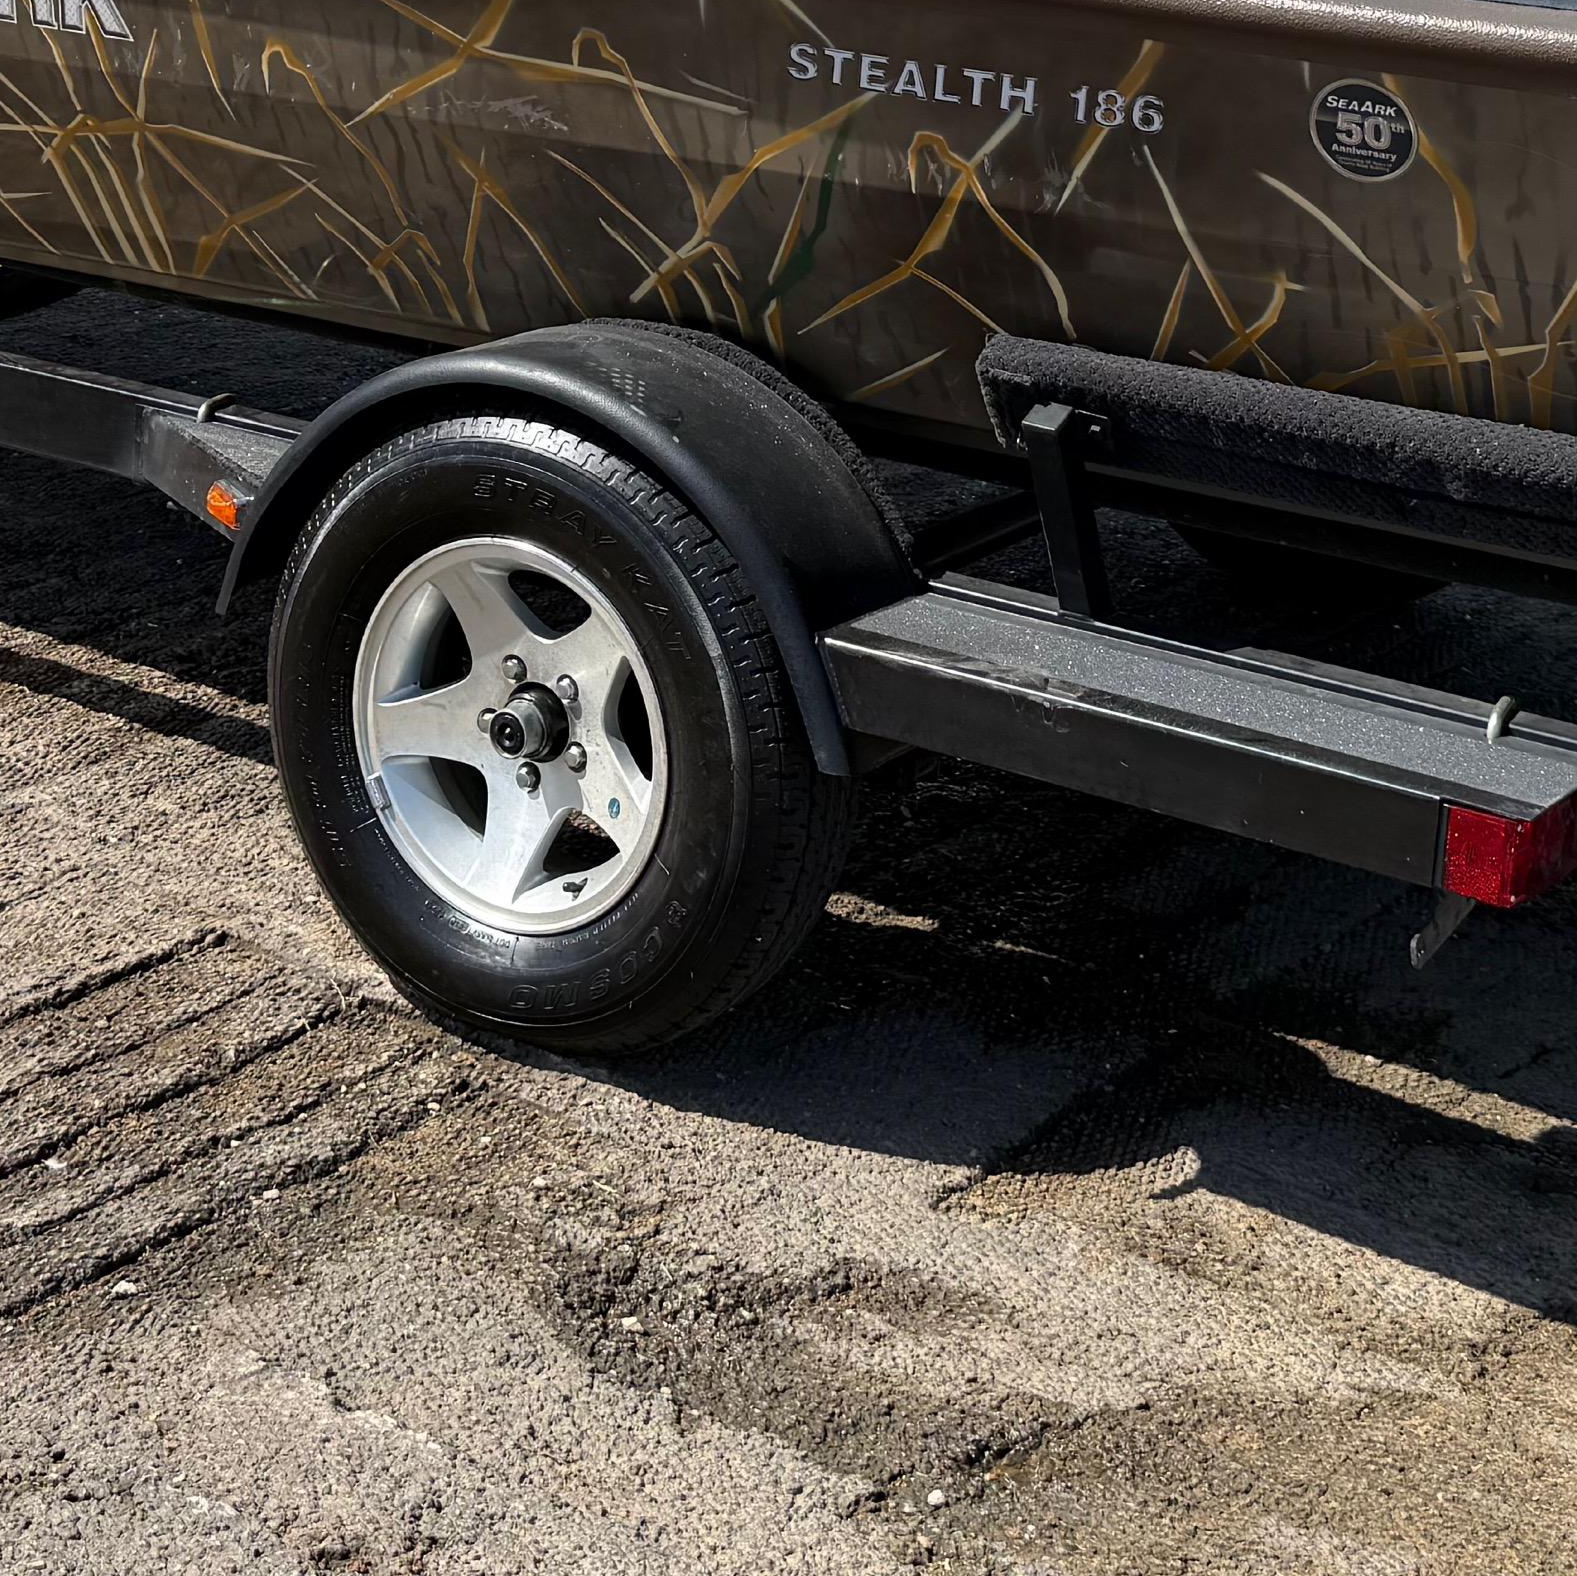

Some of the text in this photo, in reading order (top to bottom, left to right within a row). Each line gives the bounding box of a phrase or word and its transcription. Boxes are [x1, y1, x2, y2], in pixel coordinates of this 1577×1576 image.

[787, 42, 1165, 135] STEALTH 186
[1331, 143, 1398, 162] Anniversary
